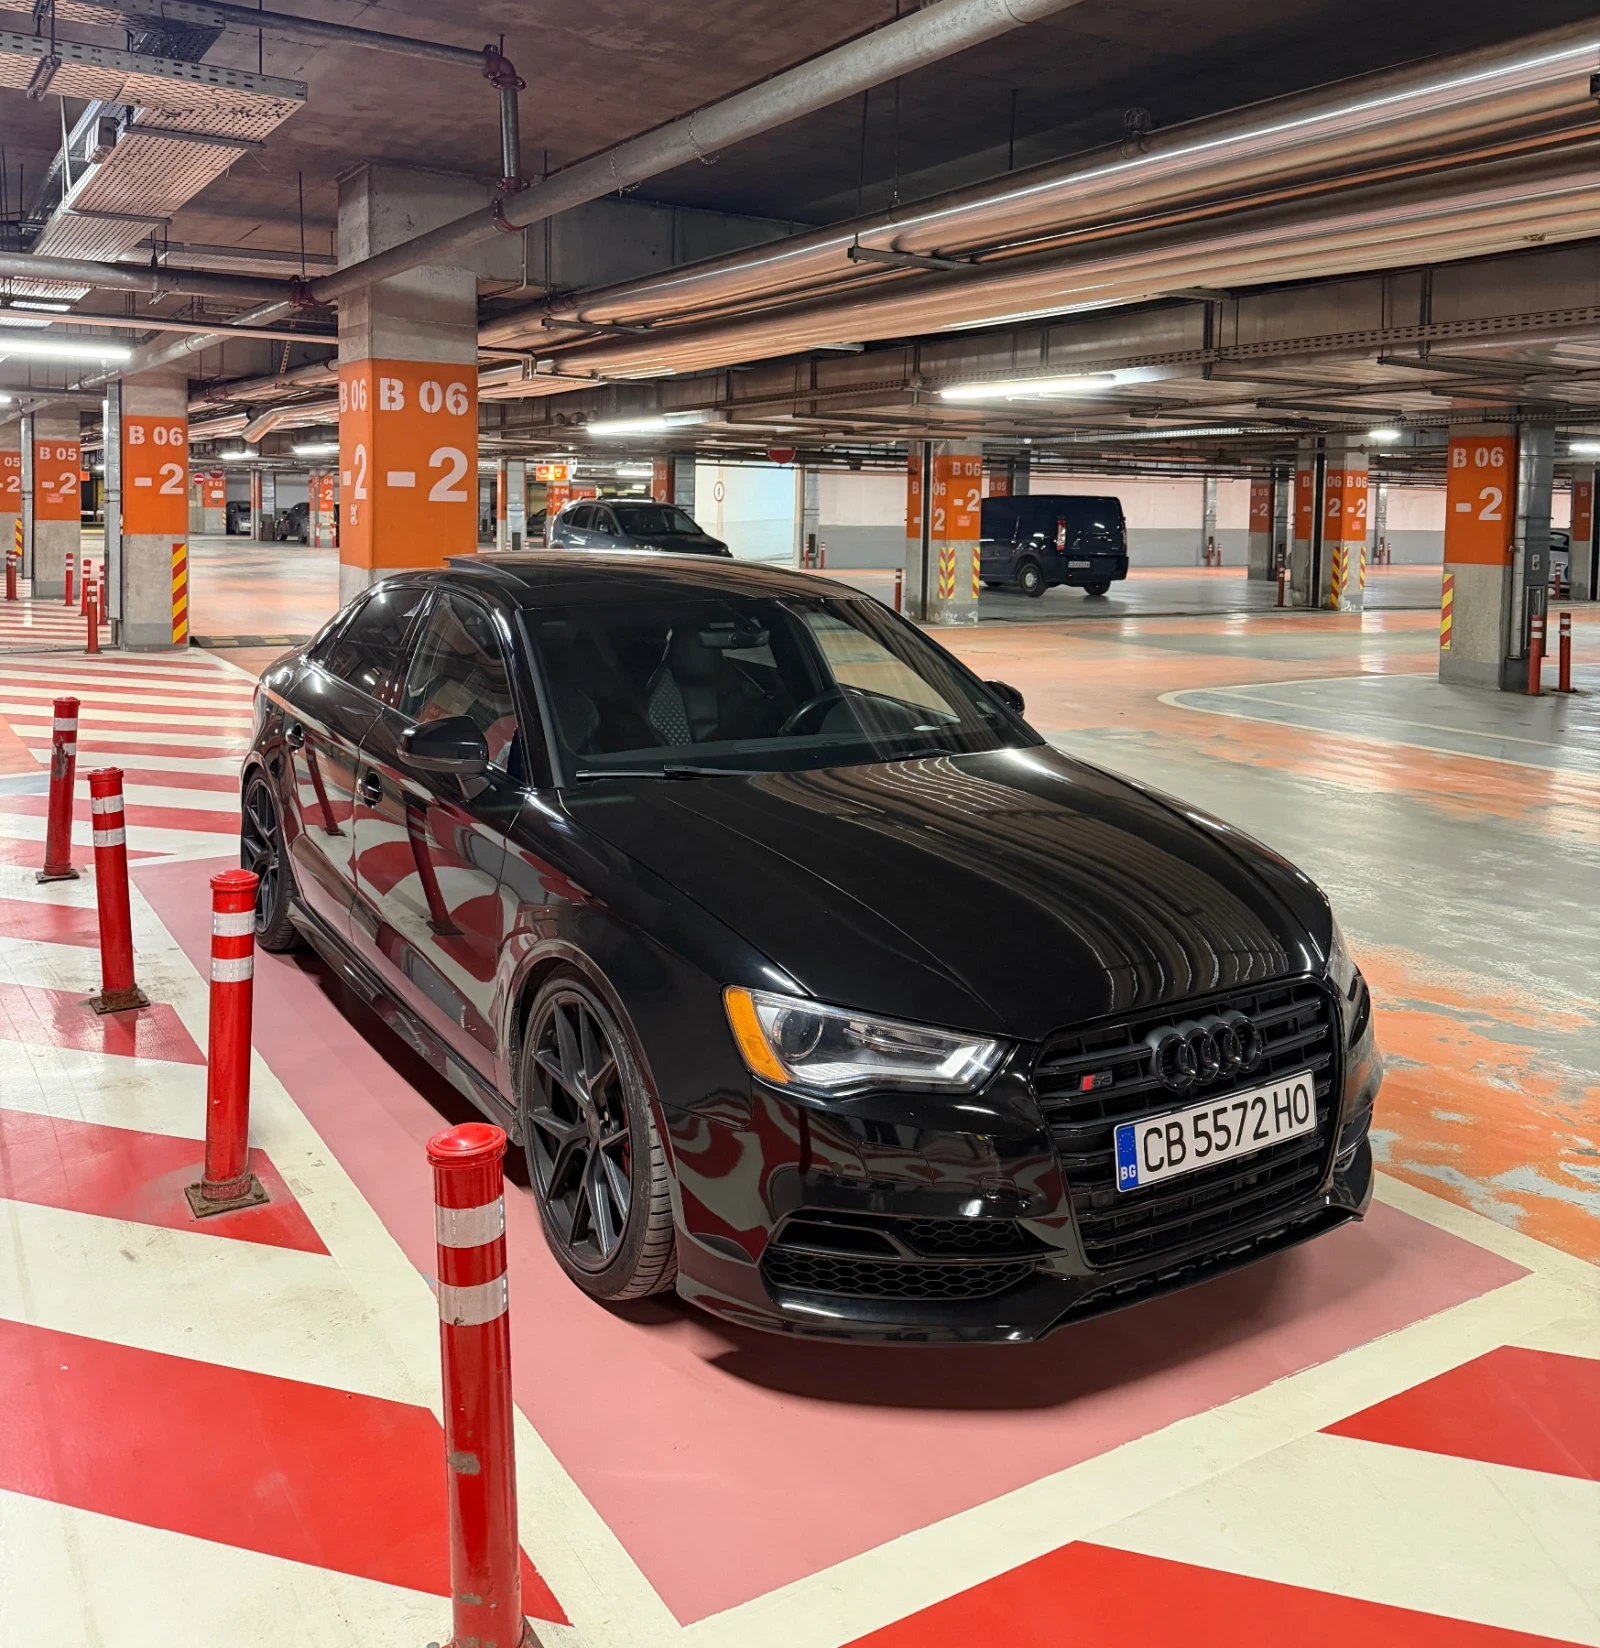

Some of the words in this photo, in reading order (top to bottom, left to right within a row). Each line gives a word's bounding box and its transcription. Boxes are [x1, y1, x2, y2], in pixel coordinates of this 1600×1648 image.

[339, 381, 348, 413] B
[351, 378, 367, 411] 06
[380, 377, 405, 411] B
[418, 380, 469, 416] 06
[128, 425, 145, 445] B
[153, 426, 184, 446] 06
[39, 447, 51, 460] B
[56, 448, 77, 461] 05
[1452, 448, 1467, 468] B
[1474, 447, 1504, 467] 06
[4, 457, 21, 467] 05
[952, 461, 961, 475] B
[965, 463, 981, 476] 06
[912, 481, 919, 494] B
[933, 482, 946, 496] 06
[990, 483, 995, 491] B
[997, 482, 1007, 491] 05
[1303, 477, 1310, 487] B
[1327, 476, 1342, 488] 06
[1346, 476, 1354, 488] B
[1356, 476, 1369, 488] 06
[1252, 488, 1257, 496] B
[1258, 488, 1269, 496] 05
[1580, 487, 1588, 496] B
[1091, 1074, 1112, 1087] S3
[1143, 1121, 1187, 1173] CB
[1193, 1096, 1269, 1158] 5572
[1272, 1083, 1310, 1134] HO
[1120, 1165, 1137, 1181] BG
